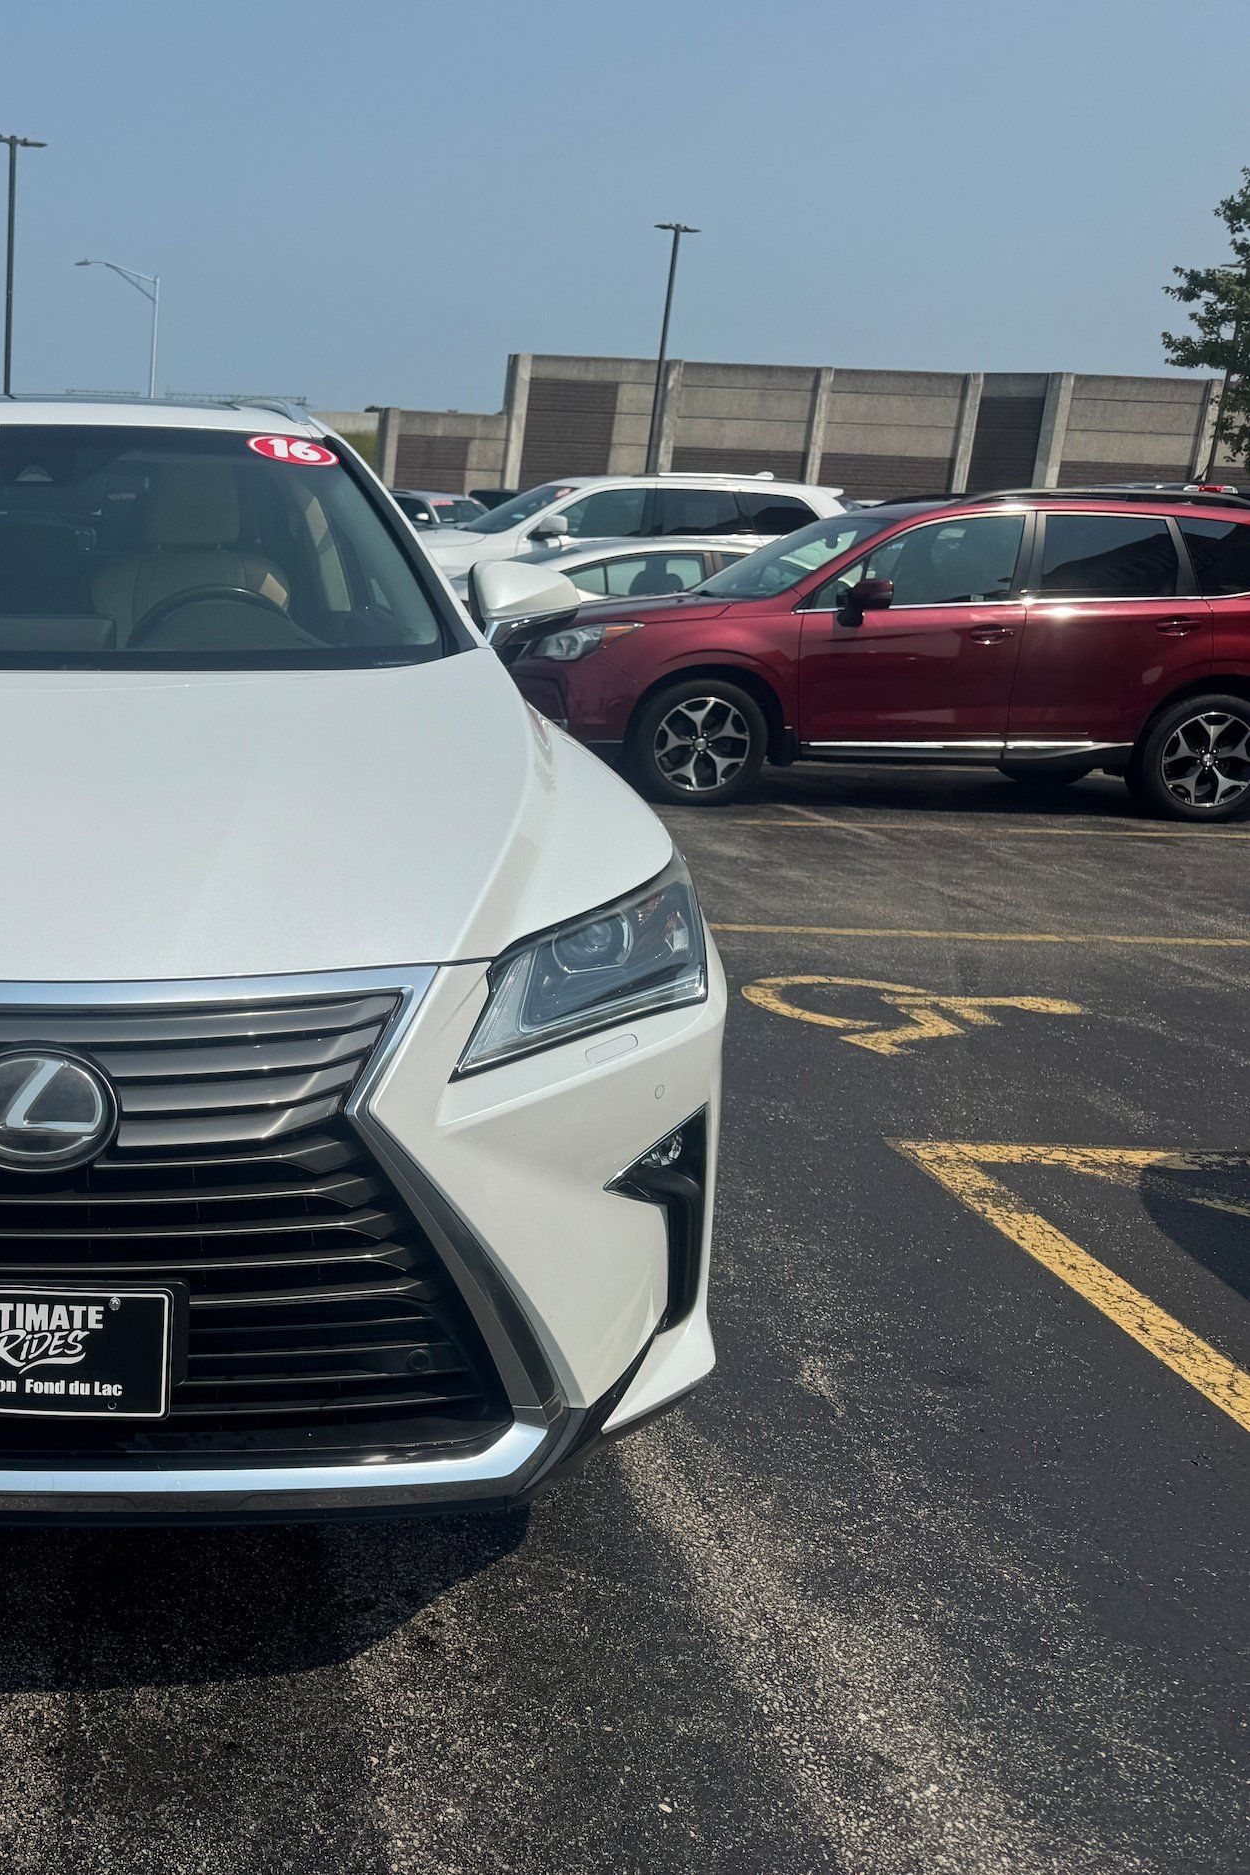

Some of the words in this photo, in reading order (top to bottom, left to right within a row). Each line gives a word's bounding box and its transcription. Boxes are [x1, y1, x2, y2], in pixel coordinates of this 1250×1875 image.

[267, 438, 321, 461] 16
[25, 1377, 65, 1395] Fond
[69, 1378, 91, 1396] du
[93, 1380, 123, 1397] Lac
